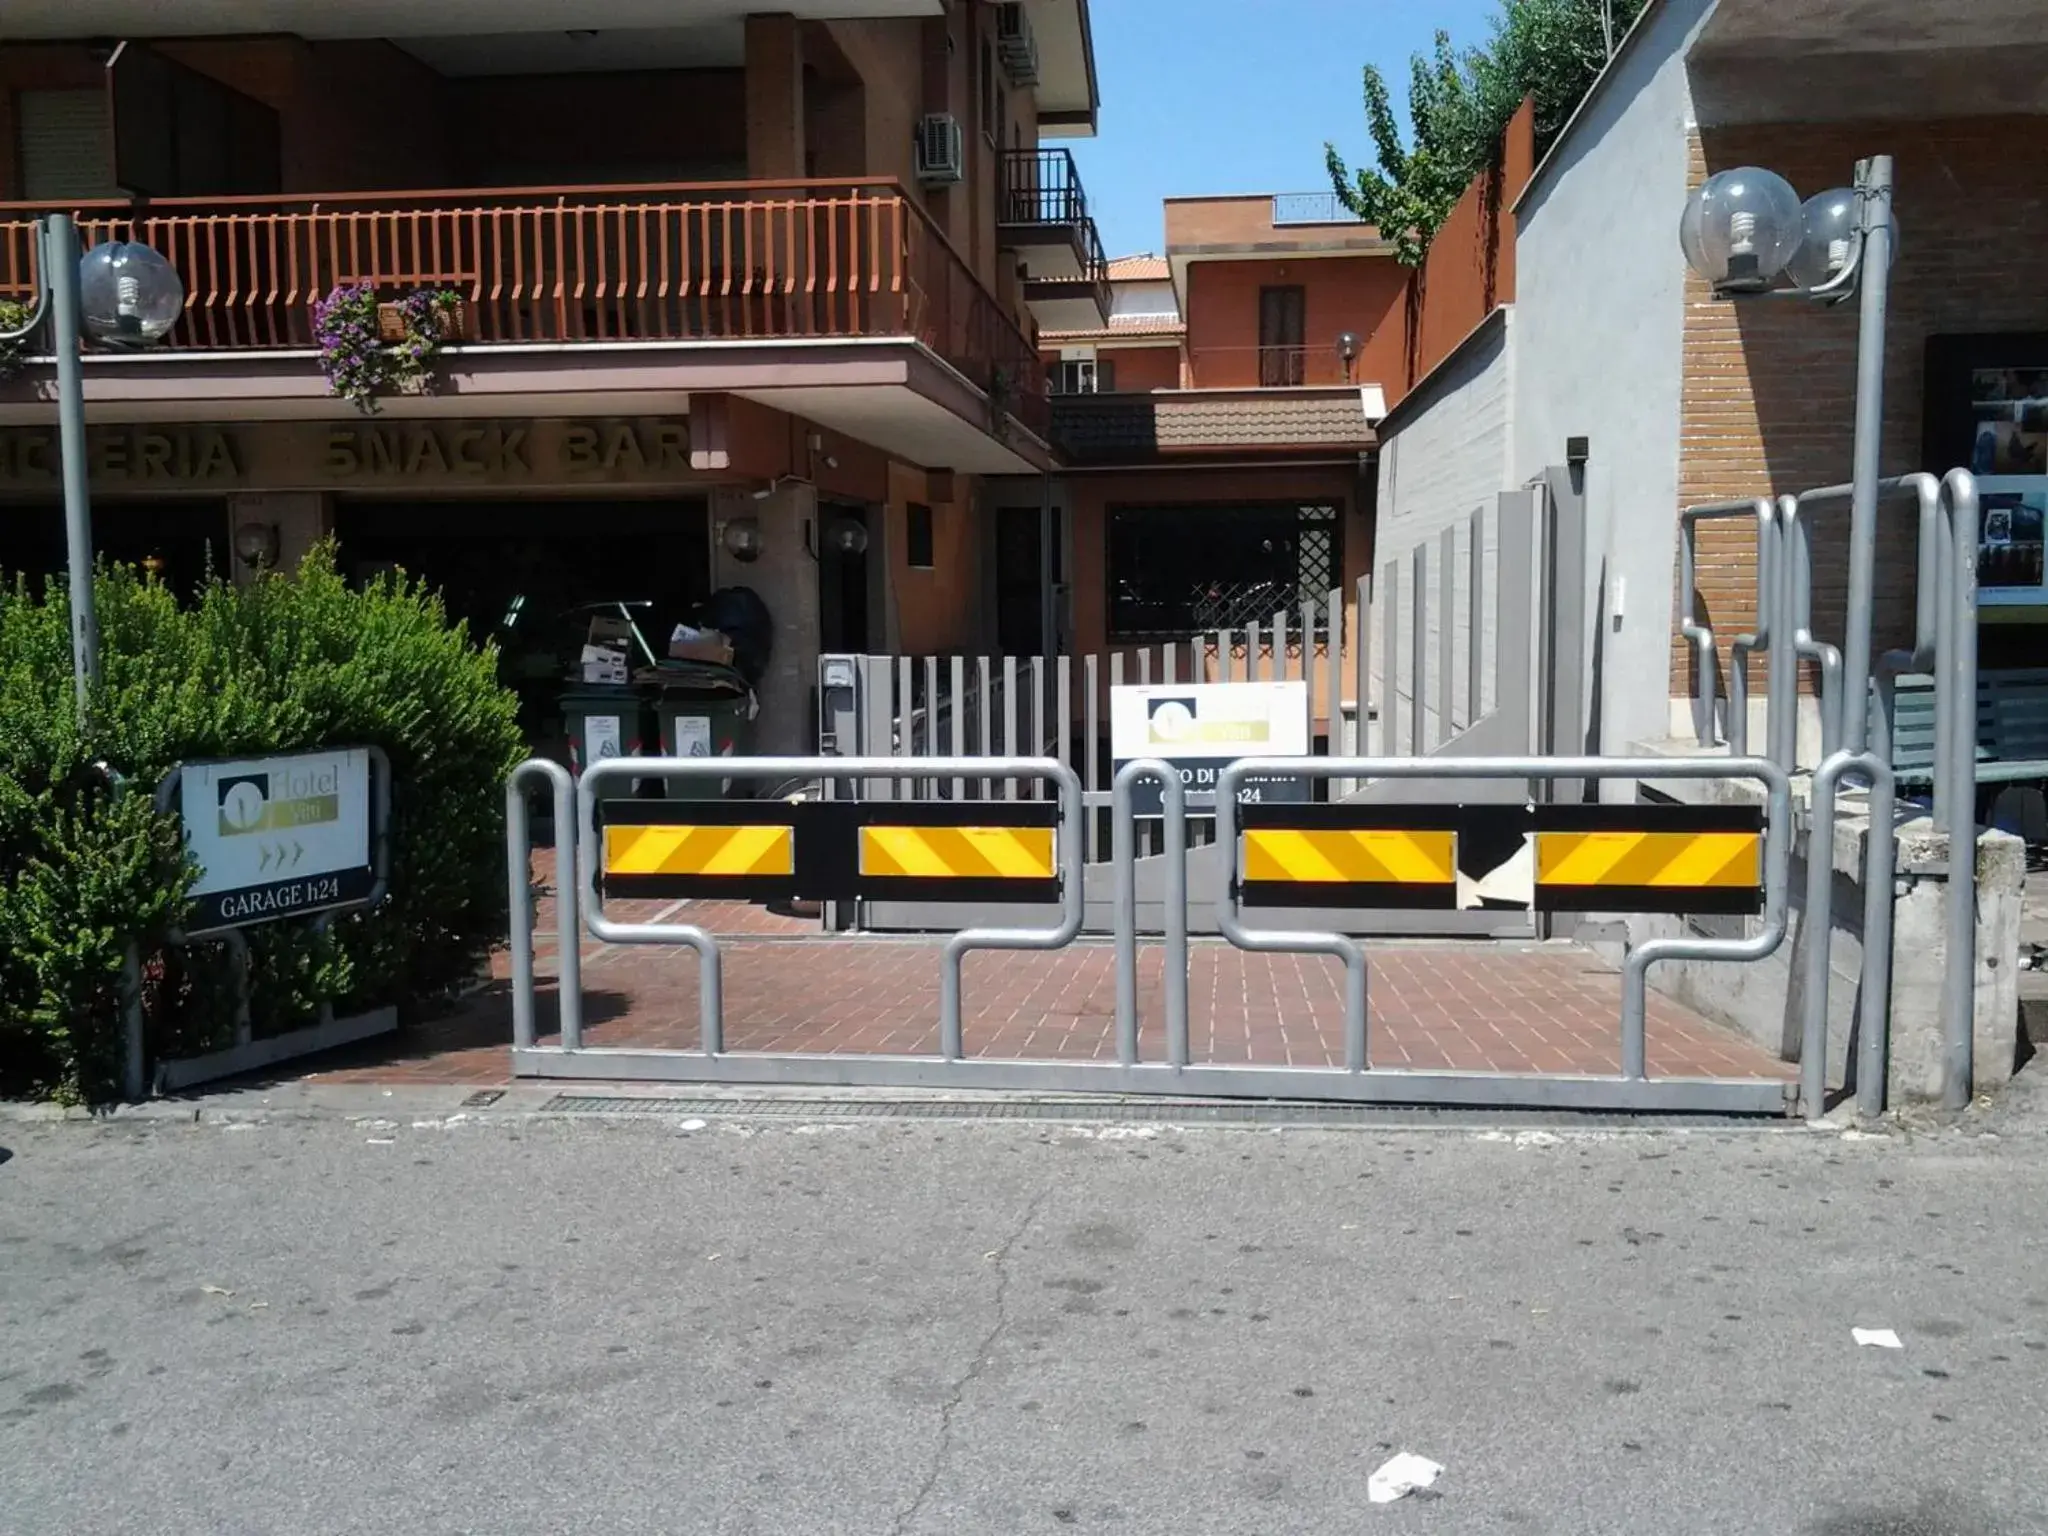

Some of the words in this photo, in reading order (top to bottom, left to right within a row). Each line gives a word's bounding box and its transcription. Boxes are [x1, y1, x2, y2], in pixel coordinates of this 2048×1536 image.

[325, 424, 531, 476] SNACK
[563, 420, 689, 473] BAR
[271, 764, 338, 800] Hotel
[1198, 768, 1215, 783] DI
[220, 885, 301, 917] GARAGE
[308, 878, 338, 901] h24
